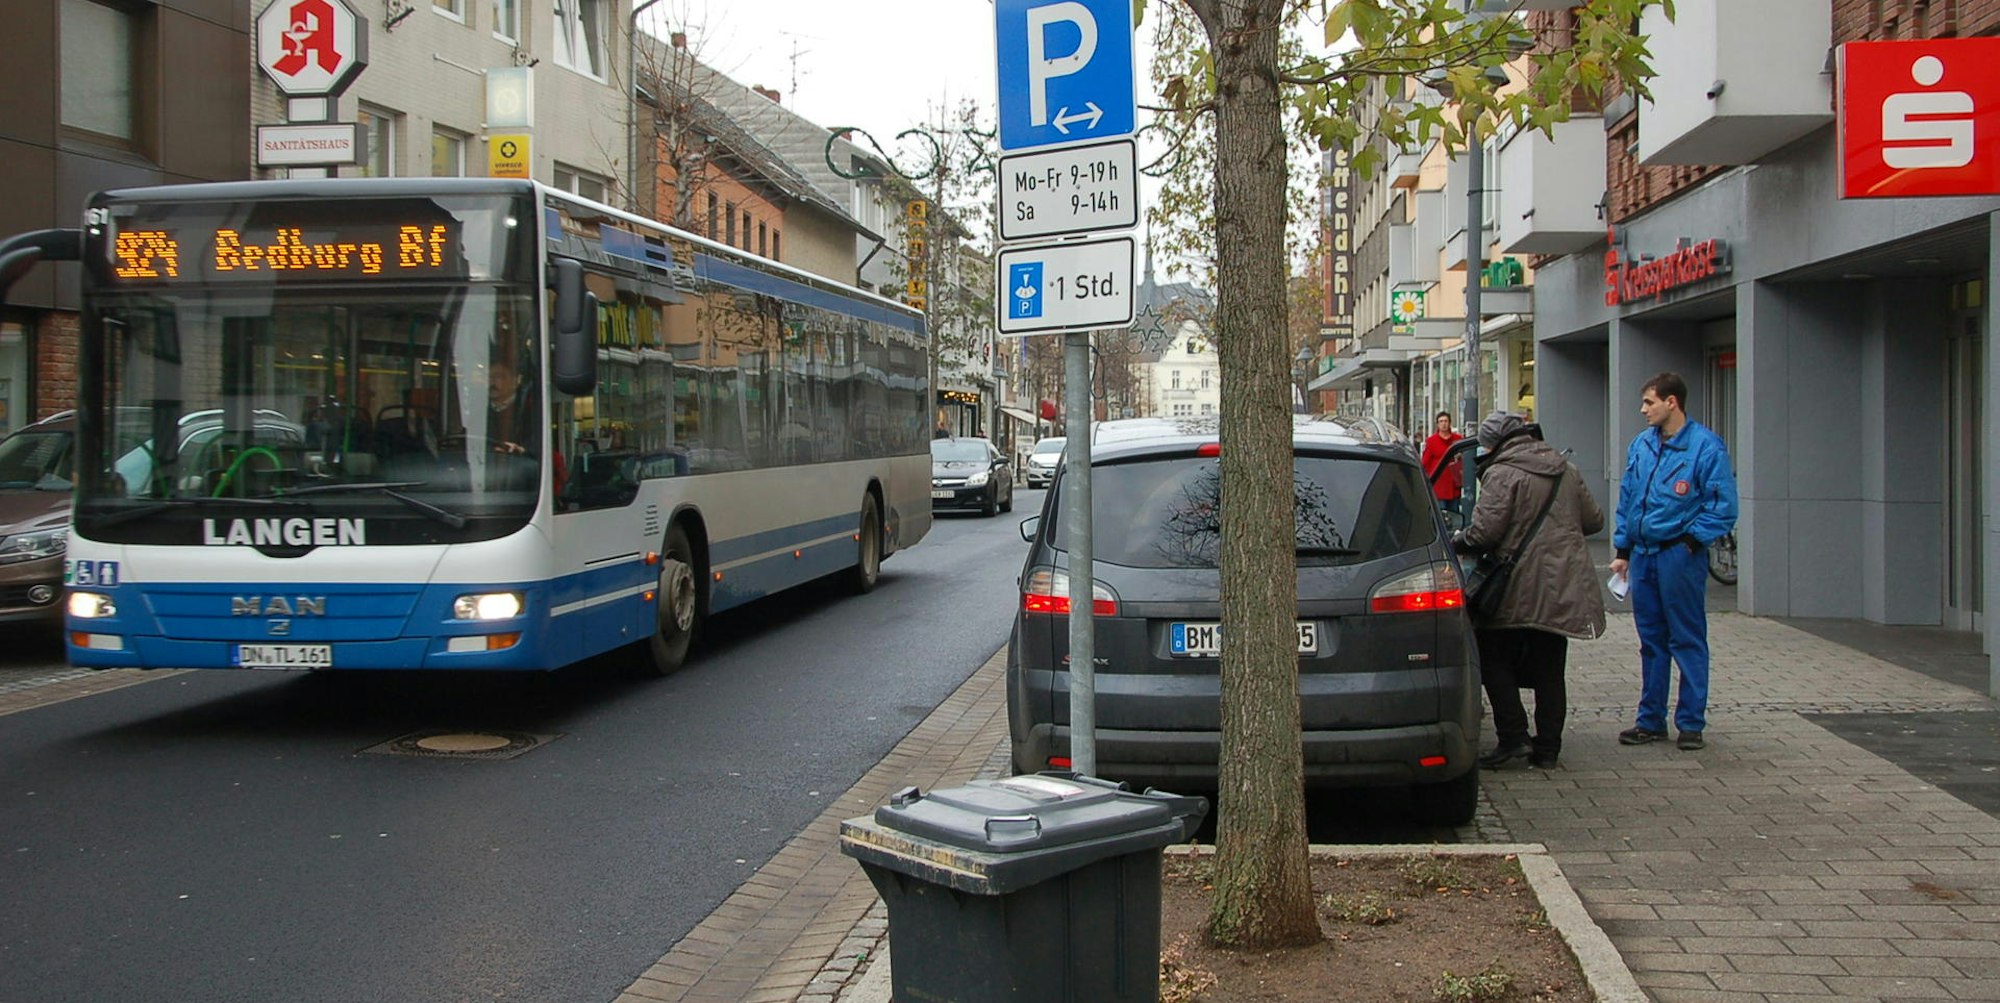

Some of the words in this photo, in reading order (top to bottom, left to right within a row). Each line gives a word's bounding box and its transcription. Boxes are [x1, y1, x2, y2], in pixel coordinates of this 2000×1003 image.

[1026, 1, 1098, 127] P
[264, 137, 350, 151] SANITÄTSHAUS
[1015, 167, 1062, 193] Mo-Fr
[1016, 200, 1035, 221] Sa
[115, 231, 178, 277] 924
[215, 229, 382, 274] Bedburg
[400, 225, 445, 267] Bf
[1075, 272, 1120, 300] Std.
[203, 518, 366, 547] LANGEN
[231, 596, 327, 616] MAN
[1186, 626, 1213, 650] BM
